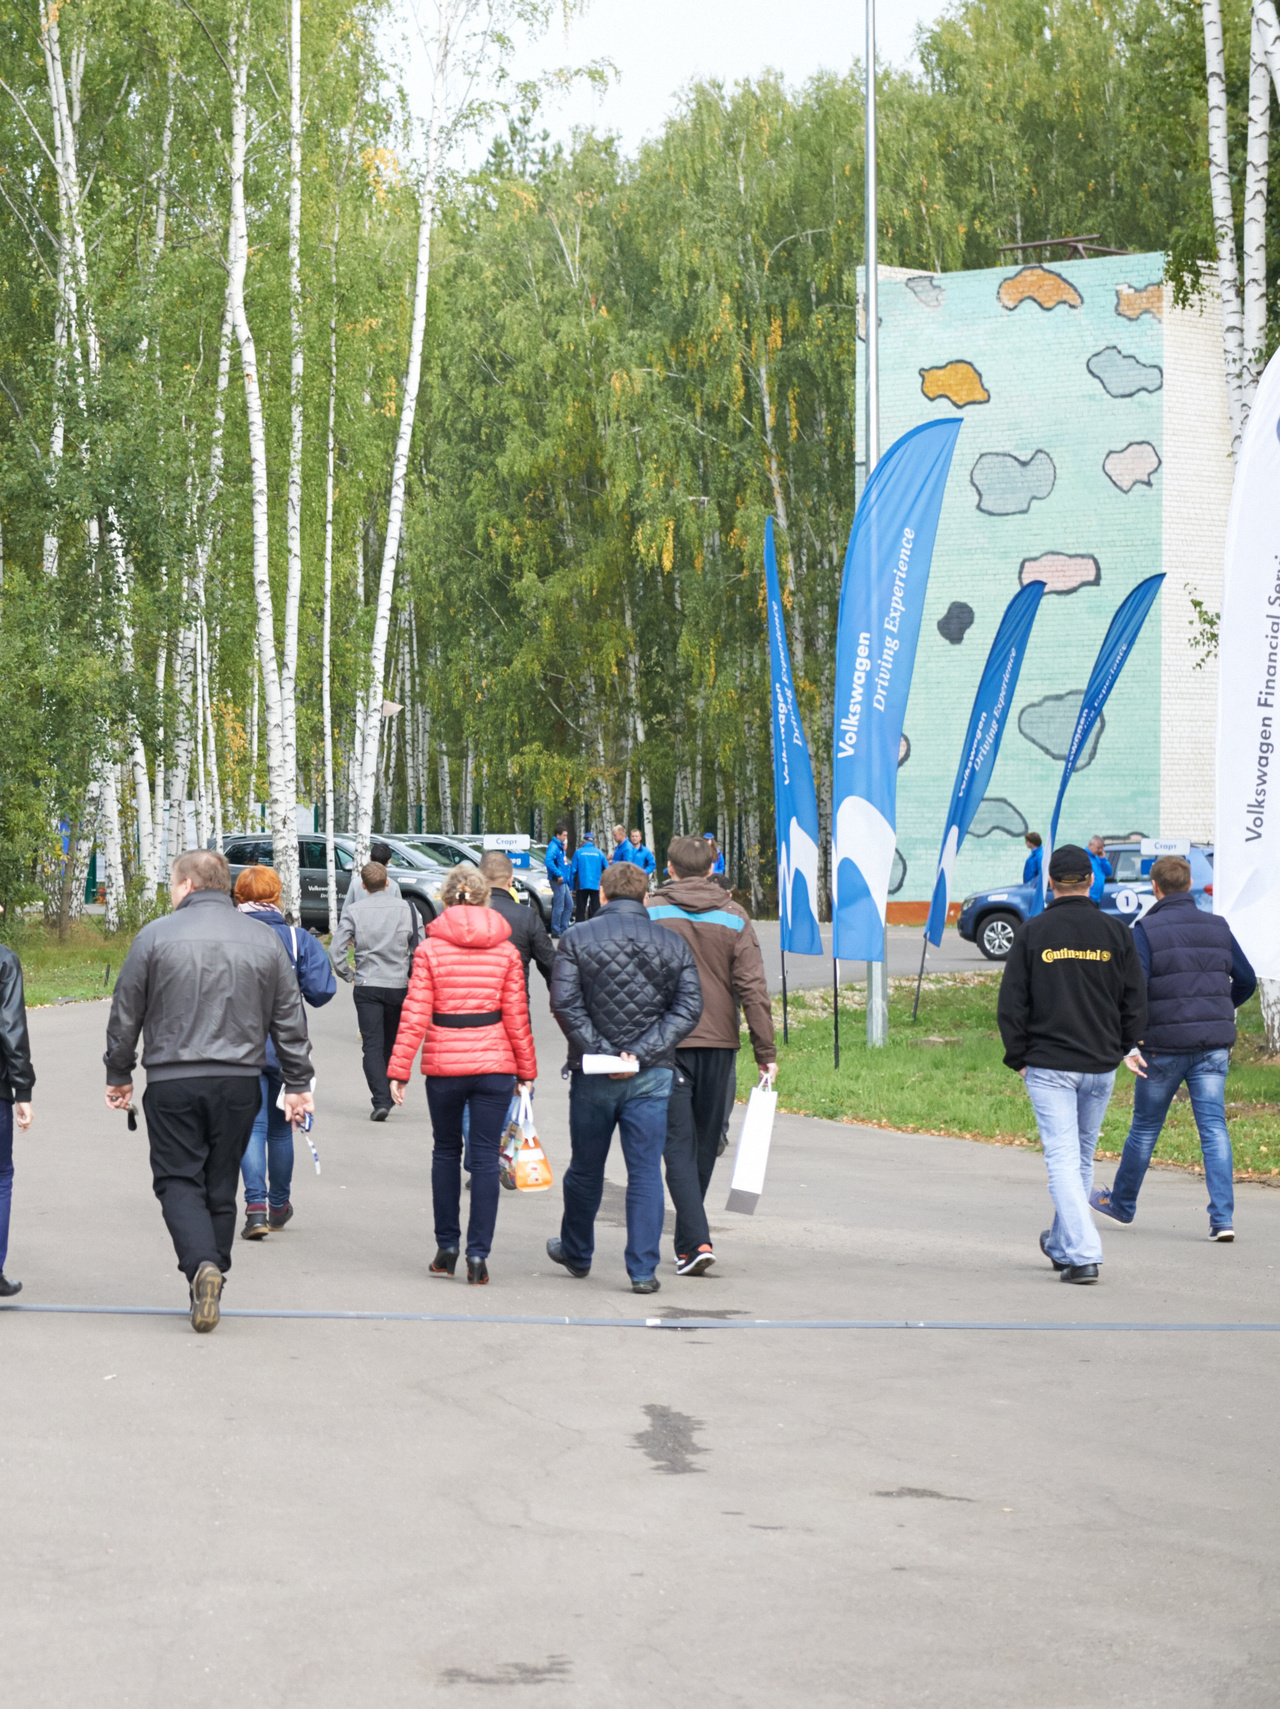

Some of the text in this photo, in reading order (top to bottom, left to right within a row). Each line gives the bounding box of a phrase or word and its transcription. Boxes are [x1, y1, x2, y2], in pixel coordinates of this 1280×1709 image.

[873, 527, 915, 713] Driving Experience
[1256, 614, 1280, 708] Financial
[837, 632, 871, 759] Volkswagen
[973, 647, 1017, 772] Driving Experience
[1244, 716, 1275, 842] Volkswagen
[495, 837, 518, 846] Старт
[1154, 842, 1177, 851] Старт
[1124, 895, 1130, 907] 1
[1041, 947, 1101, 963] Continental
